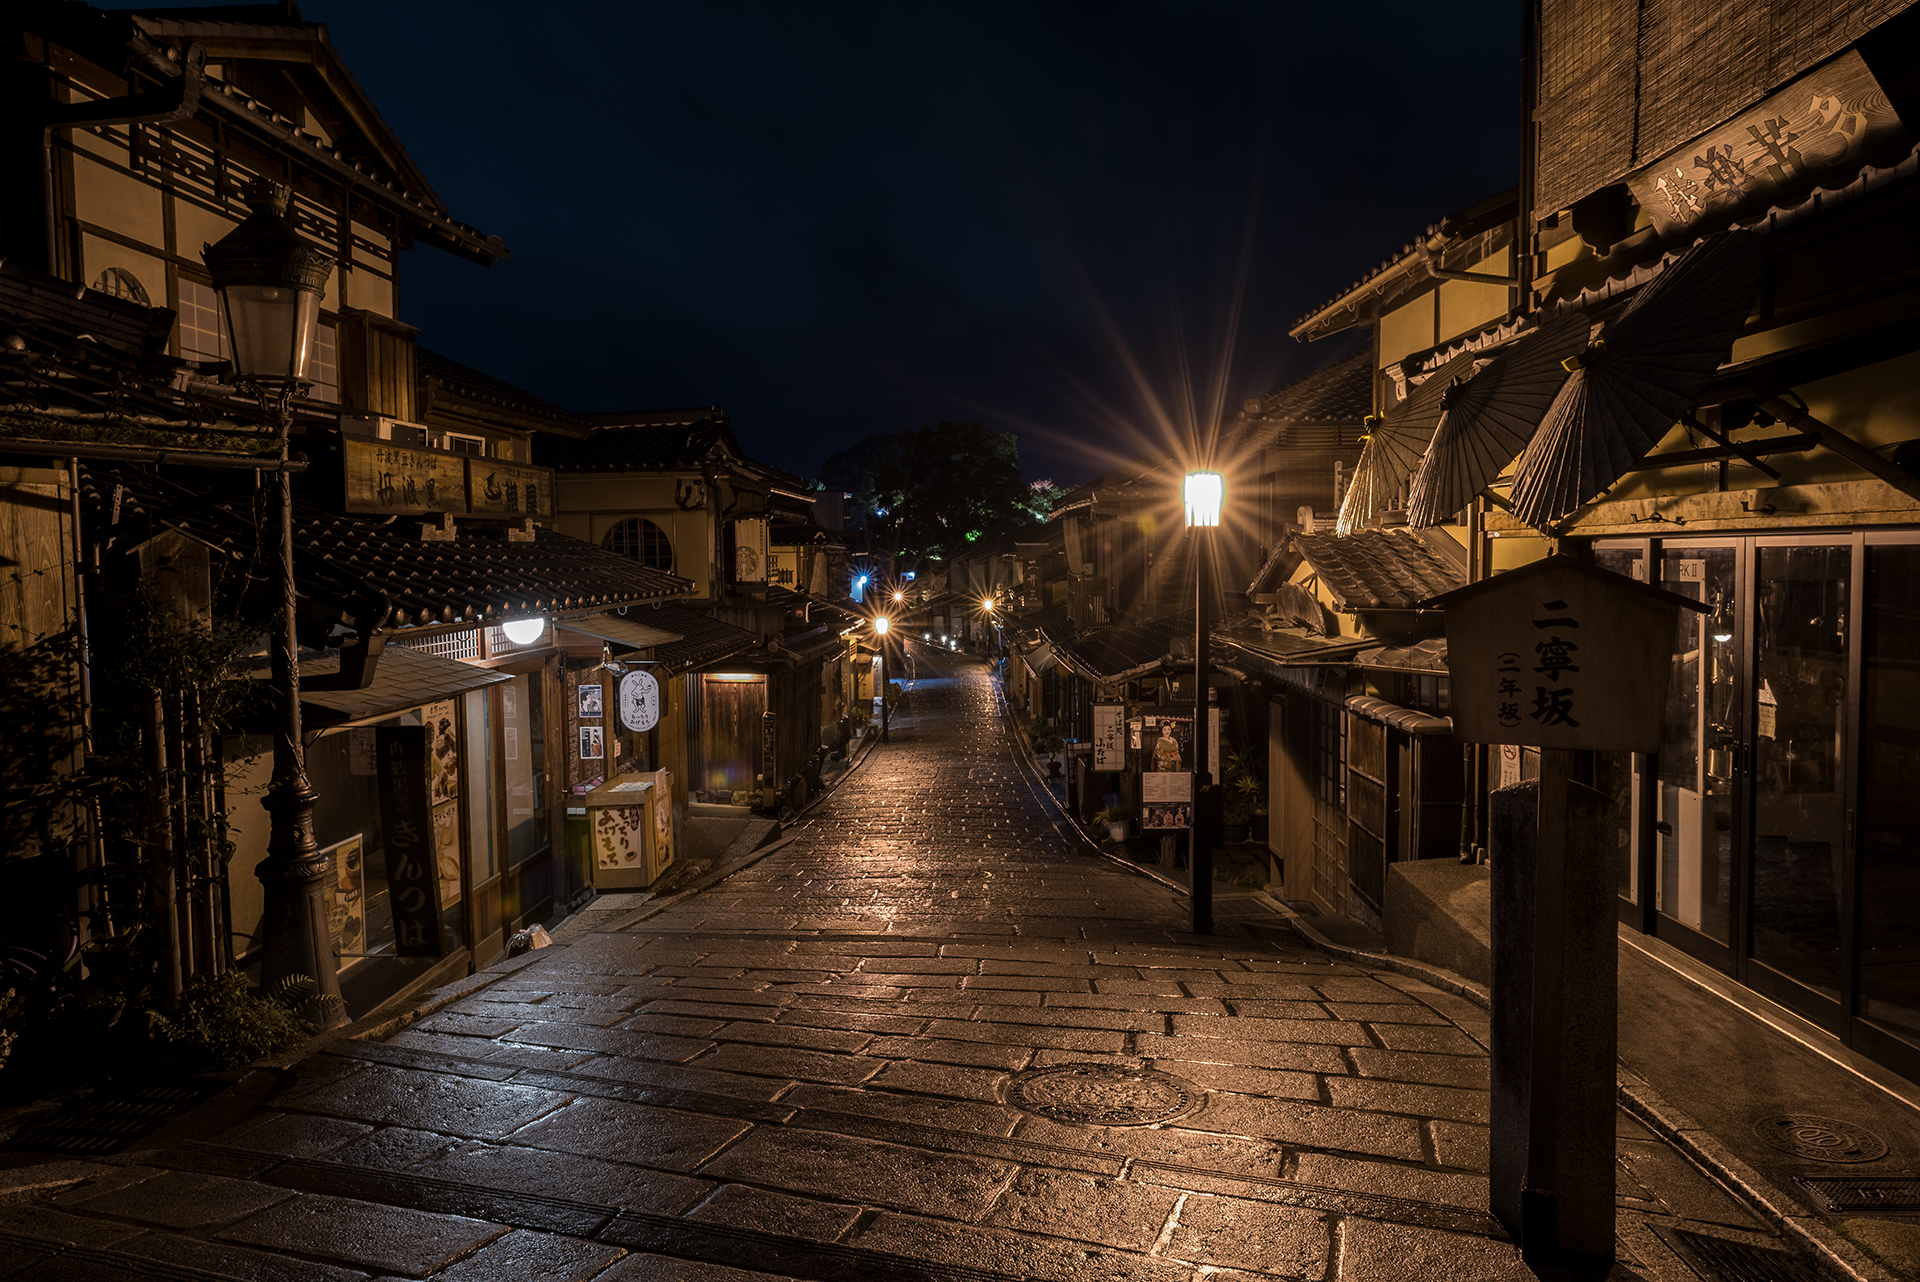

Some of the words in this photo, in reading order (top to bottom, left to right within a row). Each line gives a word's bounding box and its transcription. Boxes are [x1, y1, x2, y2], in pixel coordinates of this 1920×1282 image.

[376, 448, 438, 470] 丹波黒豆きんつば
[377, 470, 441, 509] 丹波黒
[506, 481, 538, 514] 港屋
[1530, 600, 1580, 727] 二寧坂
[1497, 653, 1522, 727] (二年坂)
[1106, 726, 1115, 750] 二寧坂
[1115, 711, 1123, 736] そば処
[1095, 738, 1107, 764] ふたば
[598, 809, 620, 866] あげもち
[617, 807, 631, 850] もっちり
